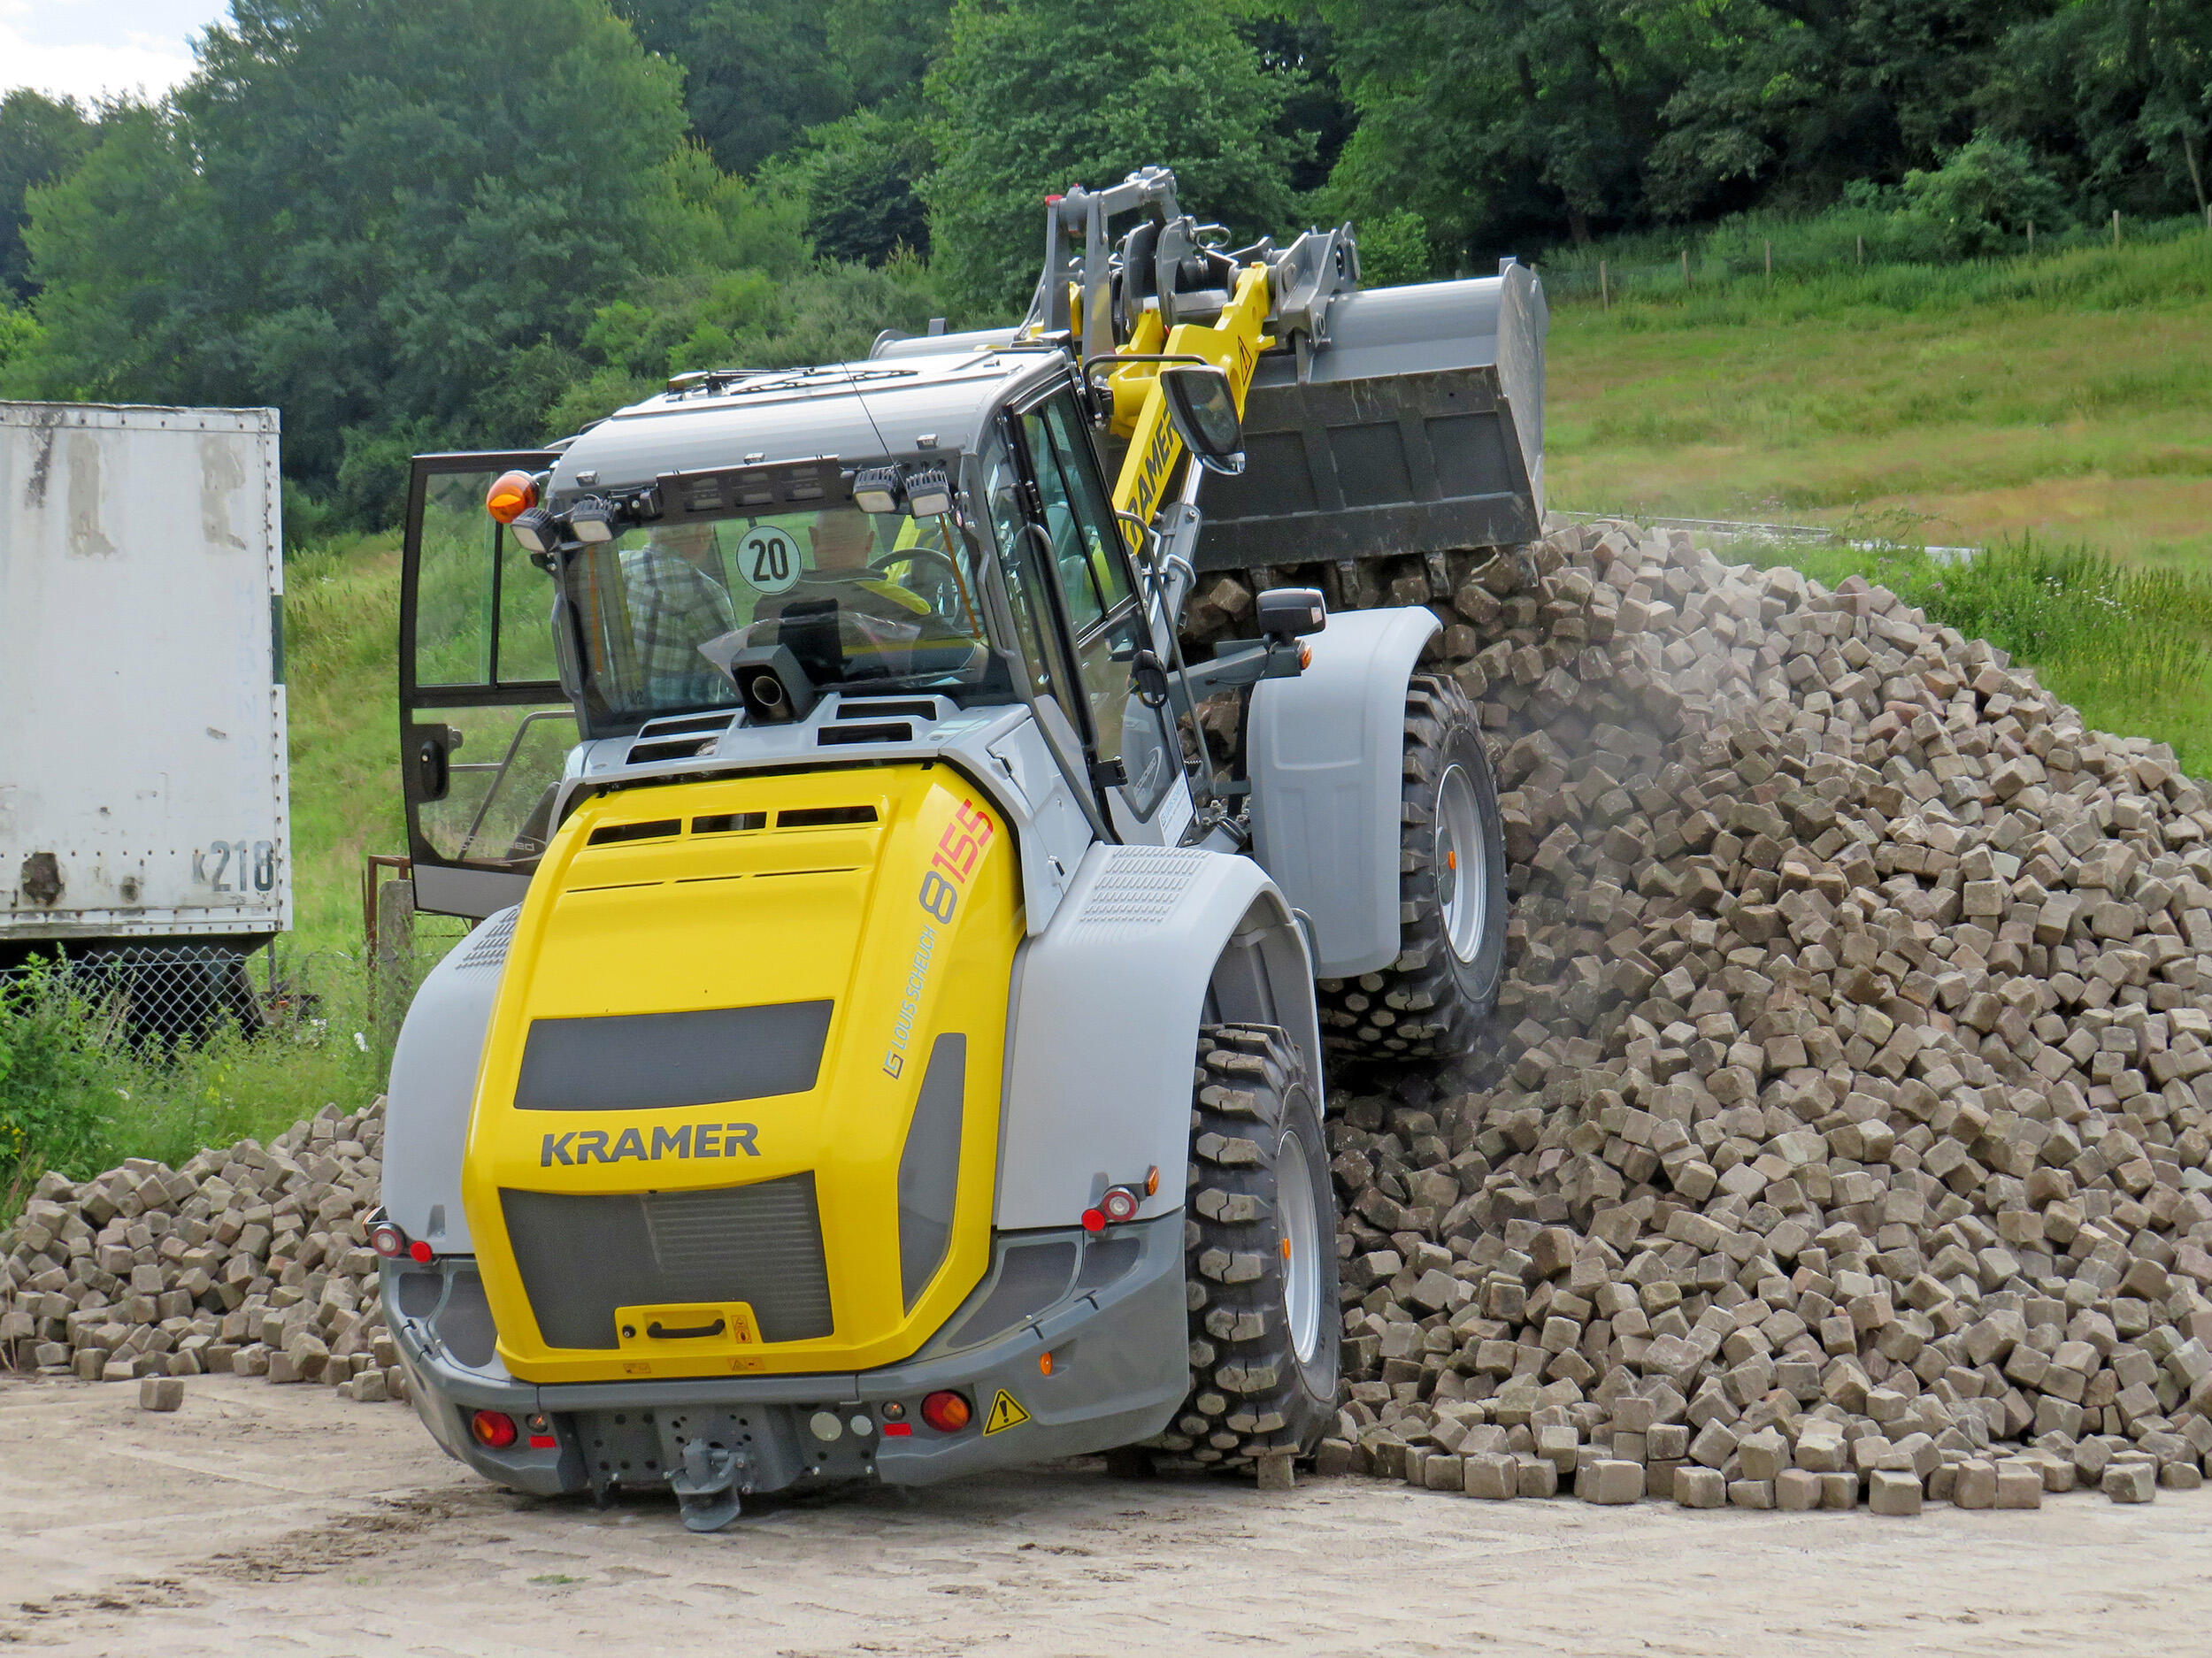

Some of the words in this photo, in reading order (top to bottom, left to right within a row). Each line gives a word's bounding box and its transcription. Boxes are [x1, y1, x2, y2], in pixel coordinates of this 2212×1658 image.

[749, 537, 789, 582] 20
[918, 798, 994, 925] 8155
[891, 999, 917, 1050] LOUIS
[906, 924, 937, 1002] SCHEUCH
[540, 1122, 762, 1167] KRAMER
